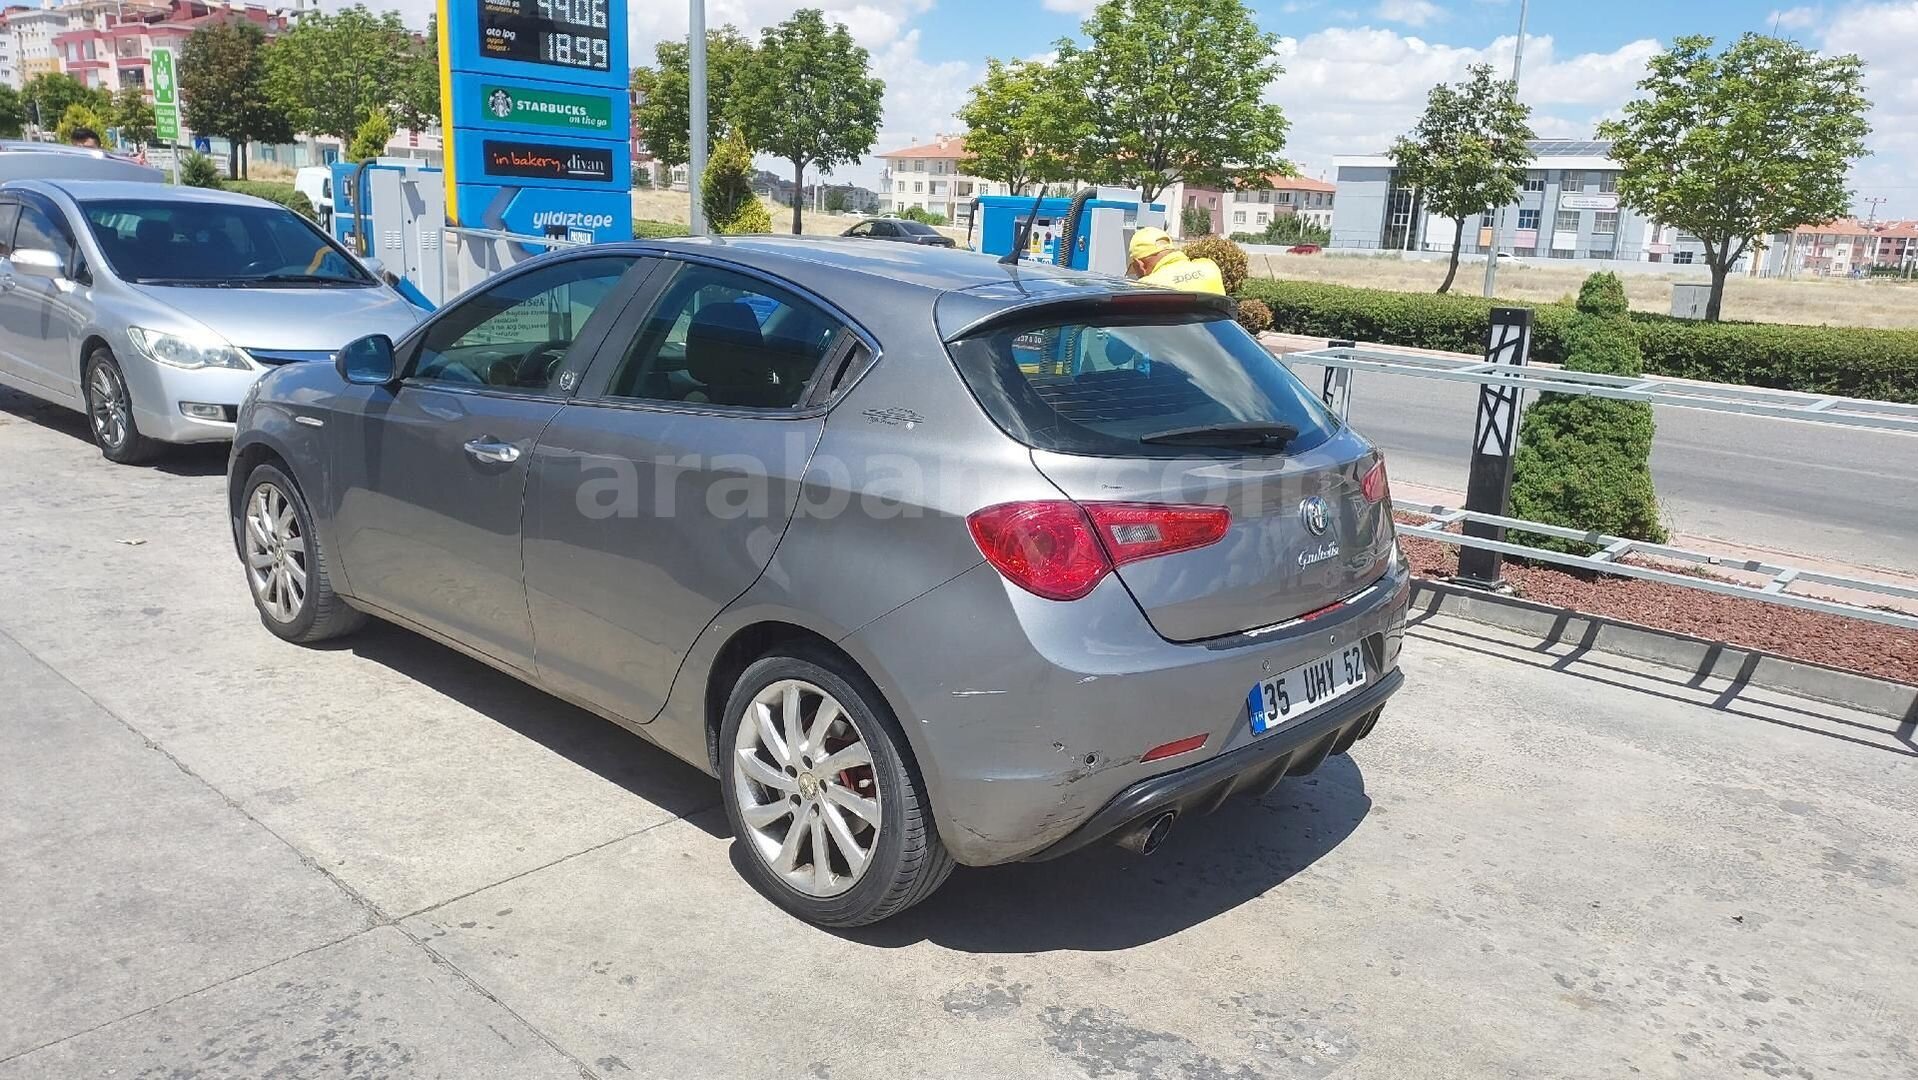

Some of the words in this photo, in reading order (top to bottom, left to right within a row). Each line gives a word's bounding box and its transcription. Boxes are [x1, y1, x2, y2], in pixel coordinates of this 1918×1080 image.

[486, 28, 501, 37] oto
[502, 28, 516, 41] lpg
[548, 33, 608, 68] 18.99
[517, 100, 587, 116] STARBUCKS
[568, 116, 580, 124] on
[581, 116, 596, 126] the
[596, 118, 607, 128] go
[494, 152, 509, 165] in
[511, 151, 561, 173] bakery
[567, 154, 604, 171] divan
[1264, 678, 1290, 721] 35
[1303, 658, 1335, 704] UHY
[1343, 646, 1363, 685] 52
[1253, 711, 1264, 722] TR
